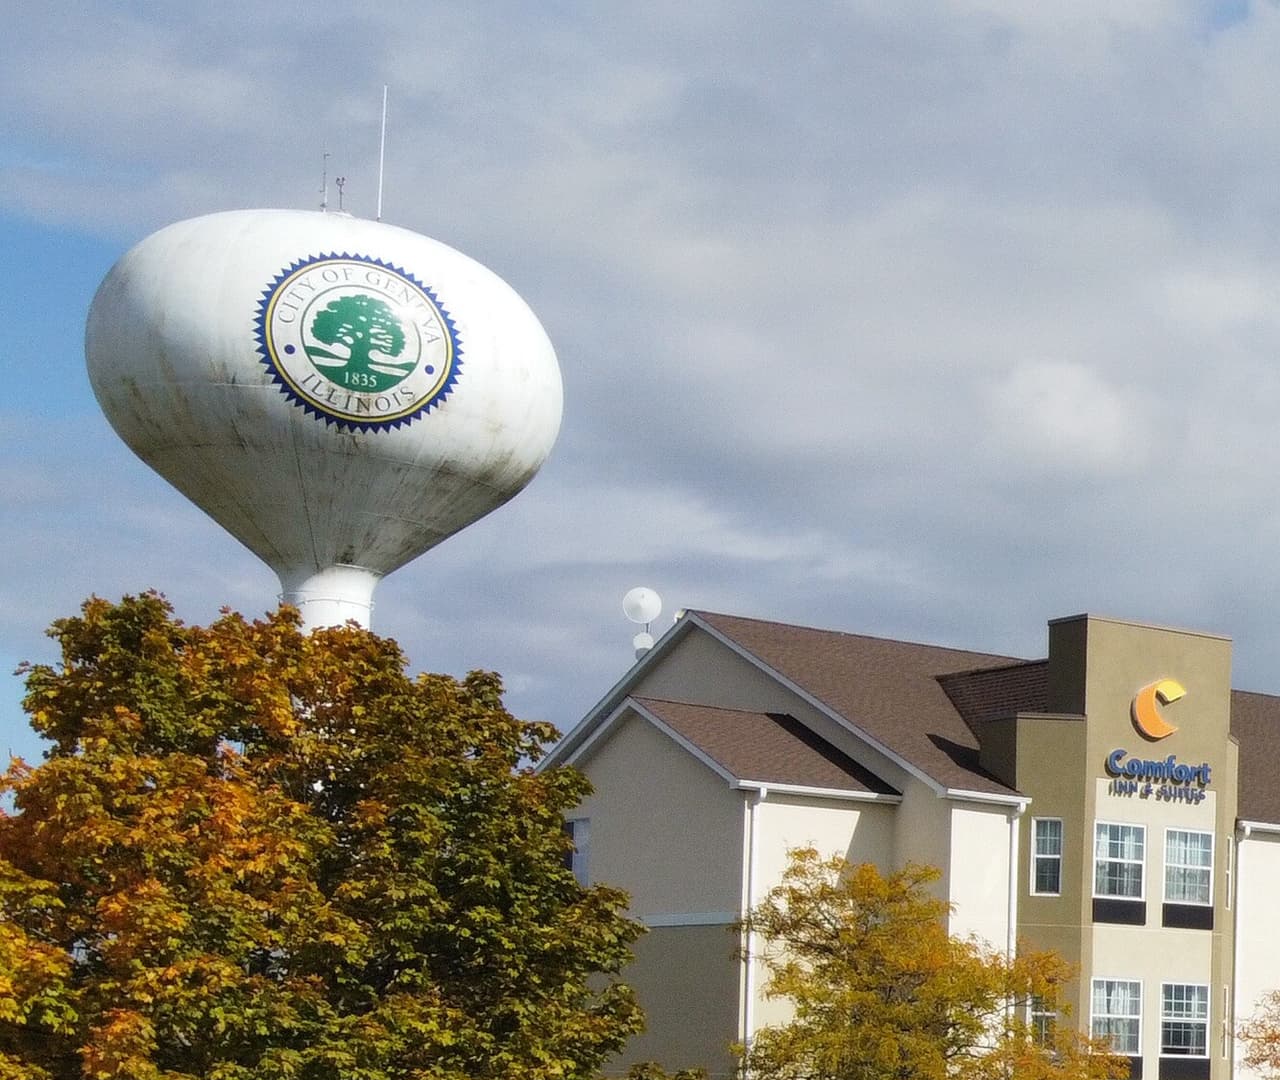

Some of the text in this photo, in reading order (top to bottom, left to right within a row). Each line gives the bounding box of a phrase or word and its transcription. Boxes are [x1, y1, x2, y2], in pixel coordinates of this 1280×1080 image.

[277, 275, 317, 324] CITY
[321, 267, 354, 284] OF
[301, 373, 417, 413] ILLINOIS
[343, 371, 378, 388] 1835
[1108, 749, 1212, 785] Comfort
[1112, 780, 1138, 793] INN
[1160, 785, 1206, 801] SUITES
